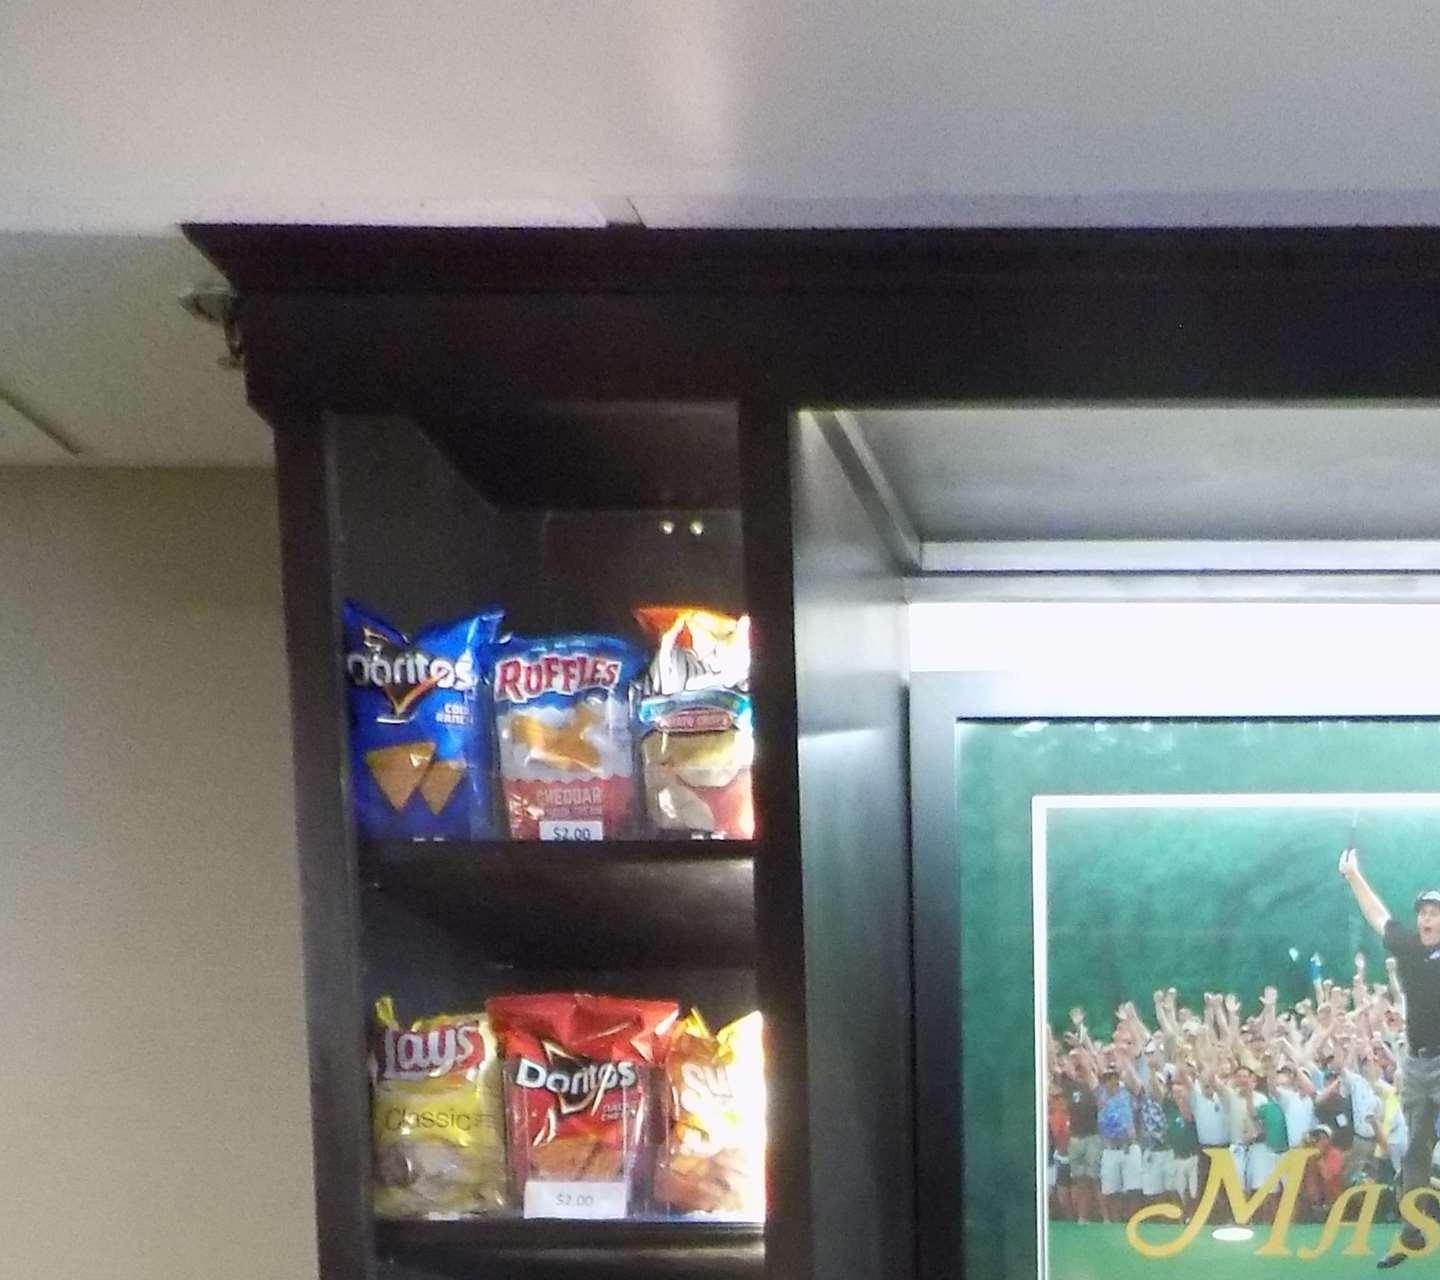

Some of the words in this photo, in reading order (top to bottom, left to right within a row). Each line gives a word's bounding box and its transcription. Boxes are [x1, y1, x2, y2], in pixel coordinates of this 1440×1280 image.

[498, 655, 622, 704] RUFFLES
[516, 1058, 637, 1094] Doritos
[386, 1107, 472, 1132] Classic
[555, 1192, 594, 1207] $2.00
